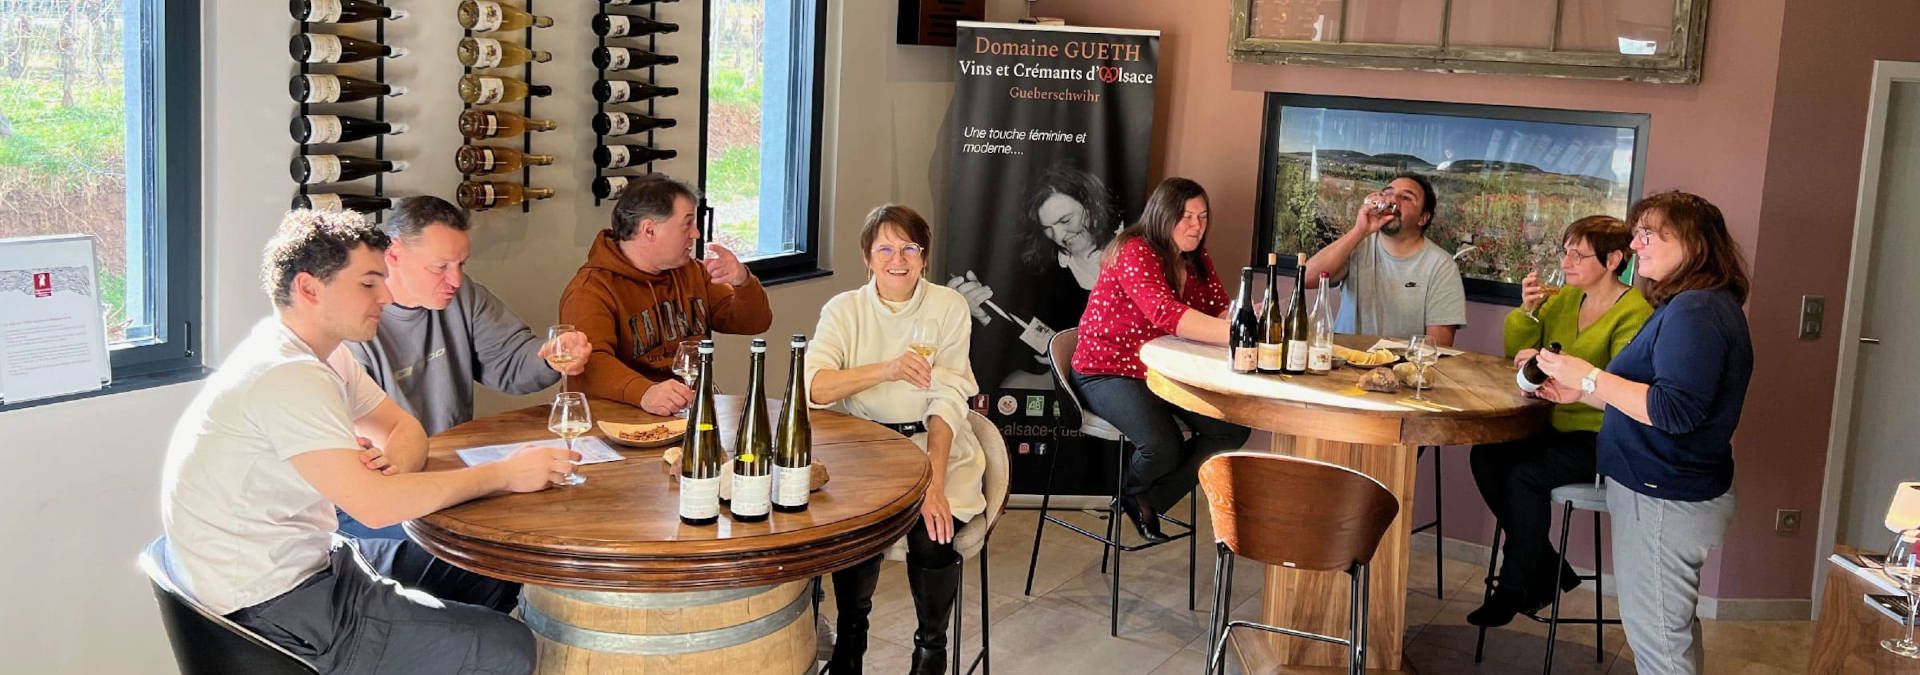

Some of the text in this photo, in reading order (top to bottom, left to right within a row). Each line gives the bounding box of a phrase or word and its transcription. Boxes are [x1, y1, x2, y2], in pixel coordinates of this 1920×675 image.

[975, 36, 1142, 62] Domaine GUETH
[959, 60, 992, 76] Vins
[996, 64, 1009, 77] et
[1013, 62, 1083, 80] Crémants
[1009, 86, 1101, 103] Gueberschwihr
[964, 126, 1087, 143] Une touche féminine et
